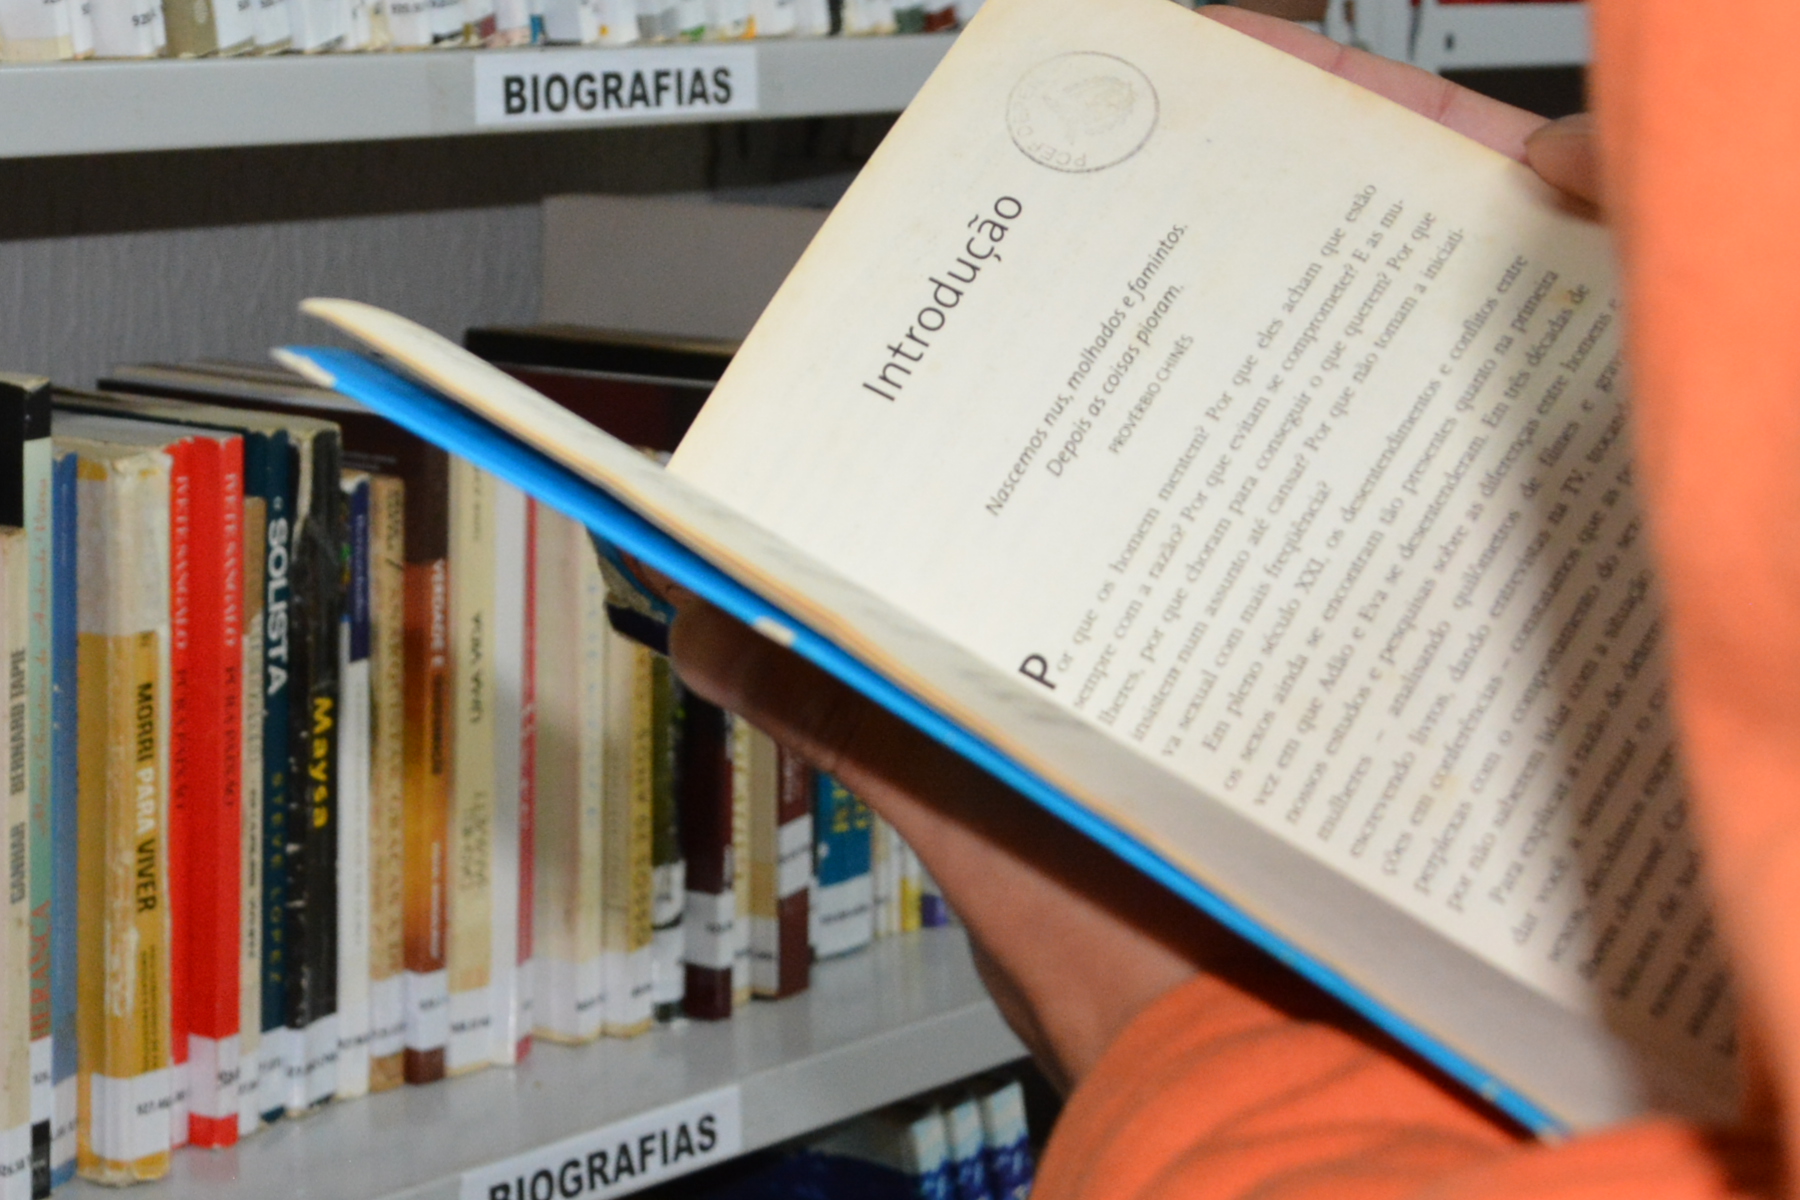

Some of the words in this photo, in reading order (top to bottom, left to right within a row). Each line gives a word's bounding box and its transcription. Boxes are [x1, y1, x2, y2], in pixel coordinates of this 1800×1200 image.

[503, 66, 732, 115] BIOGRAFIAS
[862, 195, 1022, 401] Introdução
[1120, 294, 1136, 309] e
[1126, 224, 1188, 302] famintos.
[1044, 417, 1092, 478] Depois
[1086, 394, 1107, 418] as
[1101, 343, 1141, 395] coisas
[1134, 284, 1184, 347] pioram.
[1066, 308, 1127, 391] molhados
[1107, 381, 1161, 454] PROVÉRBIO
[1154, 334, 1194, 382] CHINÊS
[1016, 651, 1073, 691] Por
[1072, 608, 1098, 645] que
[1096, 580, 1115, 602] os
[1108, 507, 1160, 574] homem
[1157, 425, 1208, 501] mentem?
[1203, 390, 1233, 422] Por
[1231, 353, 1258, 387] que
[1256, 318, 1284, 350] eles
[1281, 261, 1323, 314] acham
[1319, 226, 1346, 257] que
[1343, 183, 1377, 223] estão
[1042, 393, 1075, 427] nus,
[1073, 643, 1116, 707] sempre
[1113, 599, 1143, 640] com
[1138, 583, 1153, 597] a
[1147, 522, 1185, 579] razão?
[1178, 489, 1208, 522] Por
[1204, 453, 1231, 488] que
[1228, 395, 1270, 451] evitam
[1265, 373, 1284, 393] se
[1281, 262, 1357, 371] comprometer?
[1349, 247, 1371, 264] E
[1364, 230, 1384, 249] as
[1378, 199, 1404, 229] mu-
[984, 427, 1048, 517] Nascemos
[1097, 670, 1144, 725] lheres,
[1138, 626, 1164, 663] por
[1161, 586, 1188, 623] que
[1185, 517, 1232, 583] choram
[1227, 475, 1259, 516] para
[1255, 391, 1311, 471] conseguir
[1308, 374, 1324, 389] o
[1319, 339, 1347, 372] que
[1343, 271, 1392, 337] querem?
[1384, 242, 1414, 272] Por
[1410, 211, 1437, 241] que
[1132, 665, 1181, 741] insistem
[1176, 620, 1208, 663] num
[1204, 549, 1250, 617] assunto
[1247, 517, 1270, 547] até
[1266, 452, 1306, 515] cansar?
[1301, 420, 1332, 452] Por
[1328, 385, 1355, 419] que
[1351, 351, 1379, 384] não
[1372, 295, 1418, 349] tomam
[1412, 282, 1428, 295] a
[1421, 228, 1464, 280] iniciati-
[267, 516, 289, 696] SOLISTA
[136, 682, 153, 762] MORRI
[309, 697, 333, 829] Maysa
[137, 768, 155, 835] PARA
[136, 838, 157, 914] VIVER
